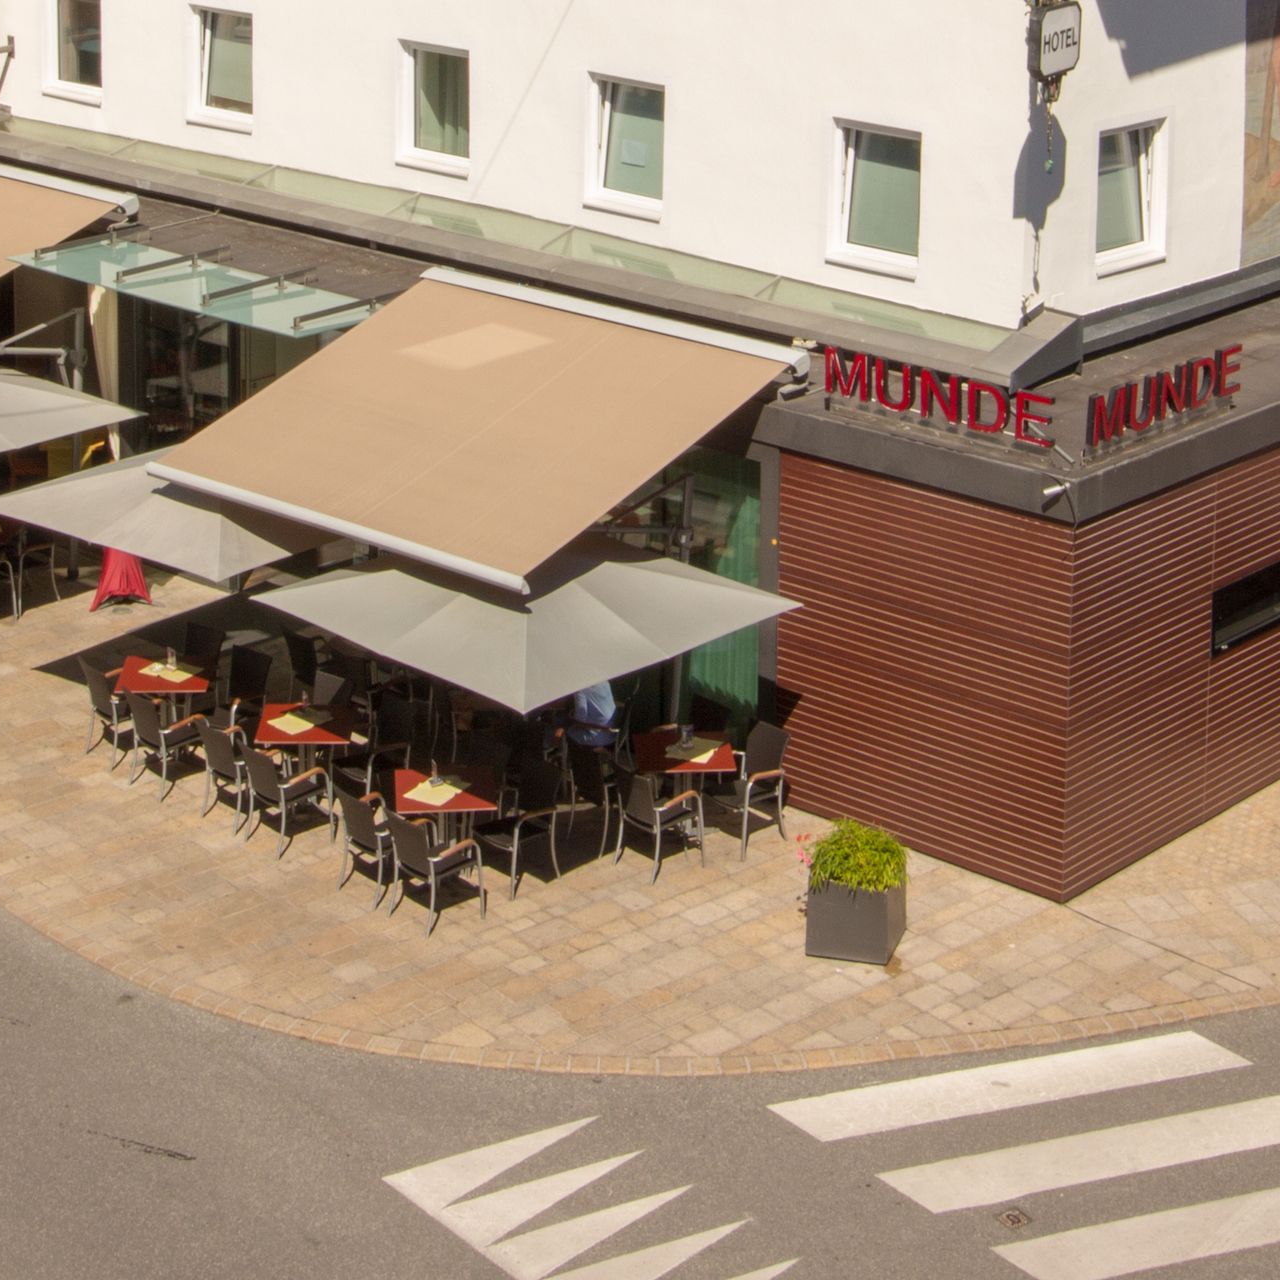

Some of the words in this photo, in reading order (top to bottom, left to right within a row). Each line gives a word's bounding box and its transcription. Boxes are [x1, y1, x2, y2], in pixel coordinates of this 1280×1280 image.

[1043, 26, 1078, 55] HOTEL
[824, 346, 1056, 449] MUNDE
[1086, 343, 1243, 448] MUNDE
